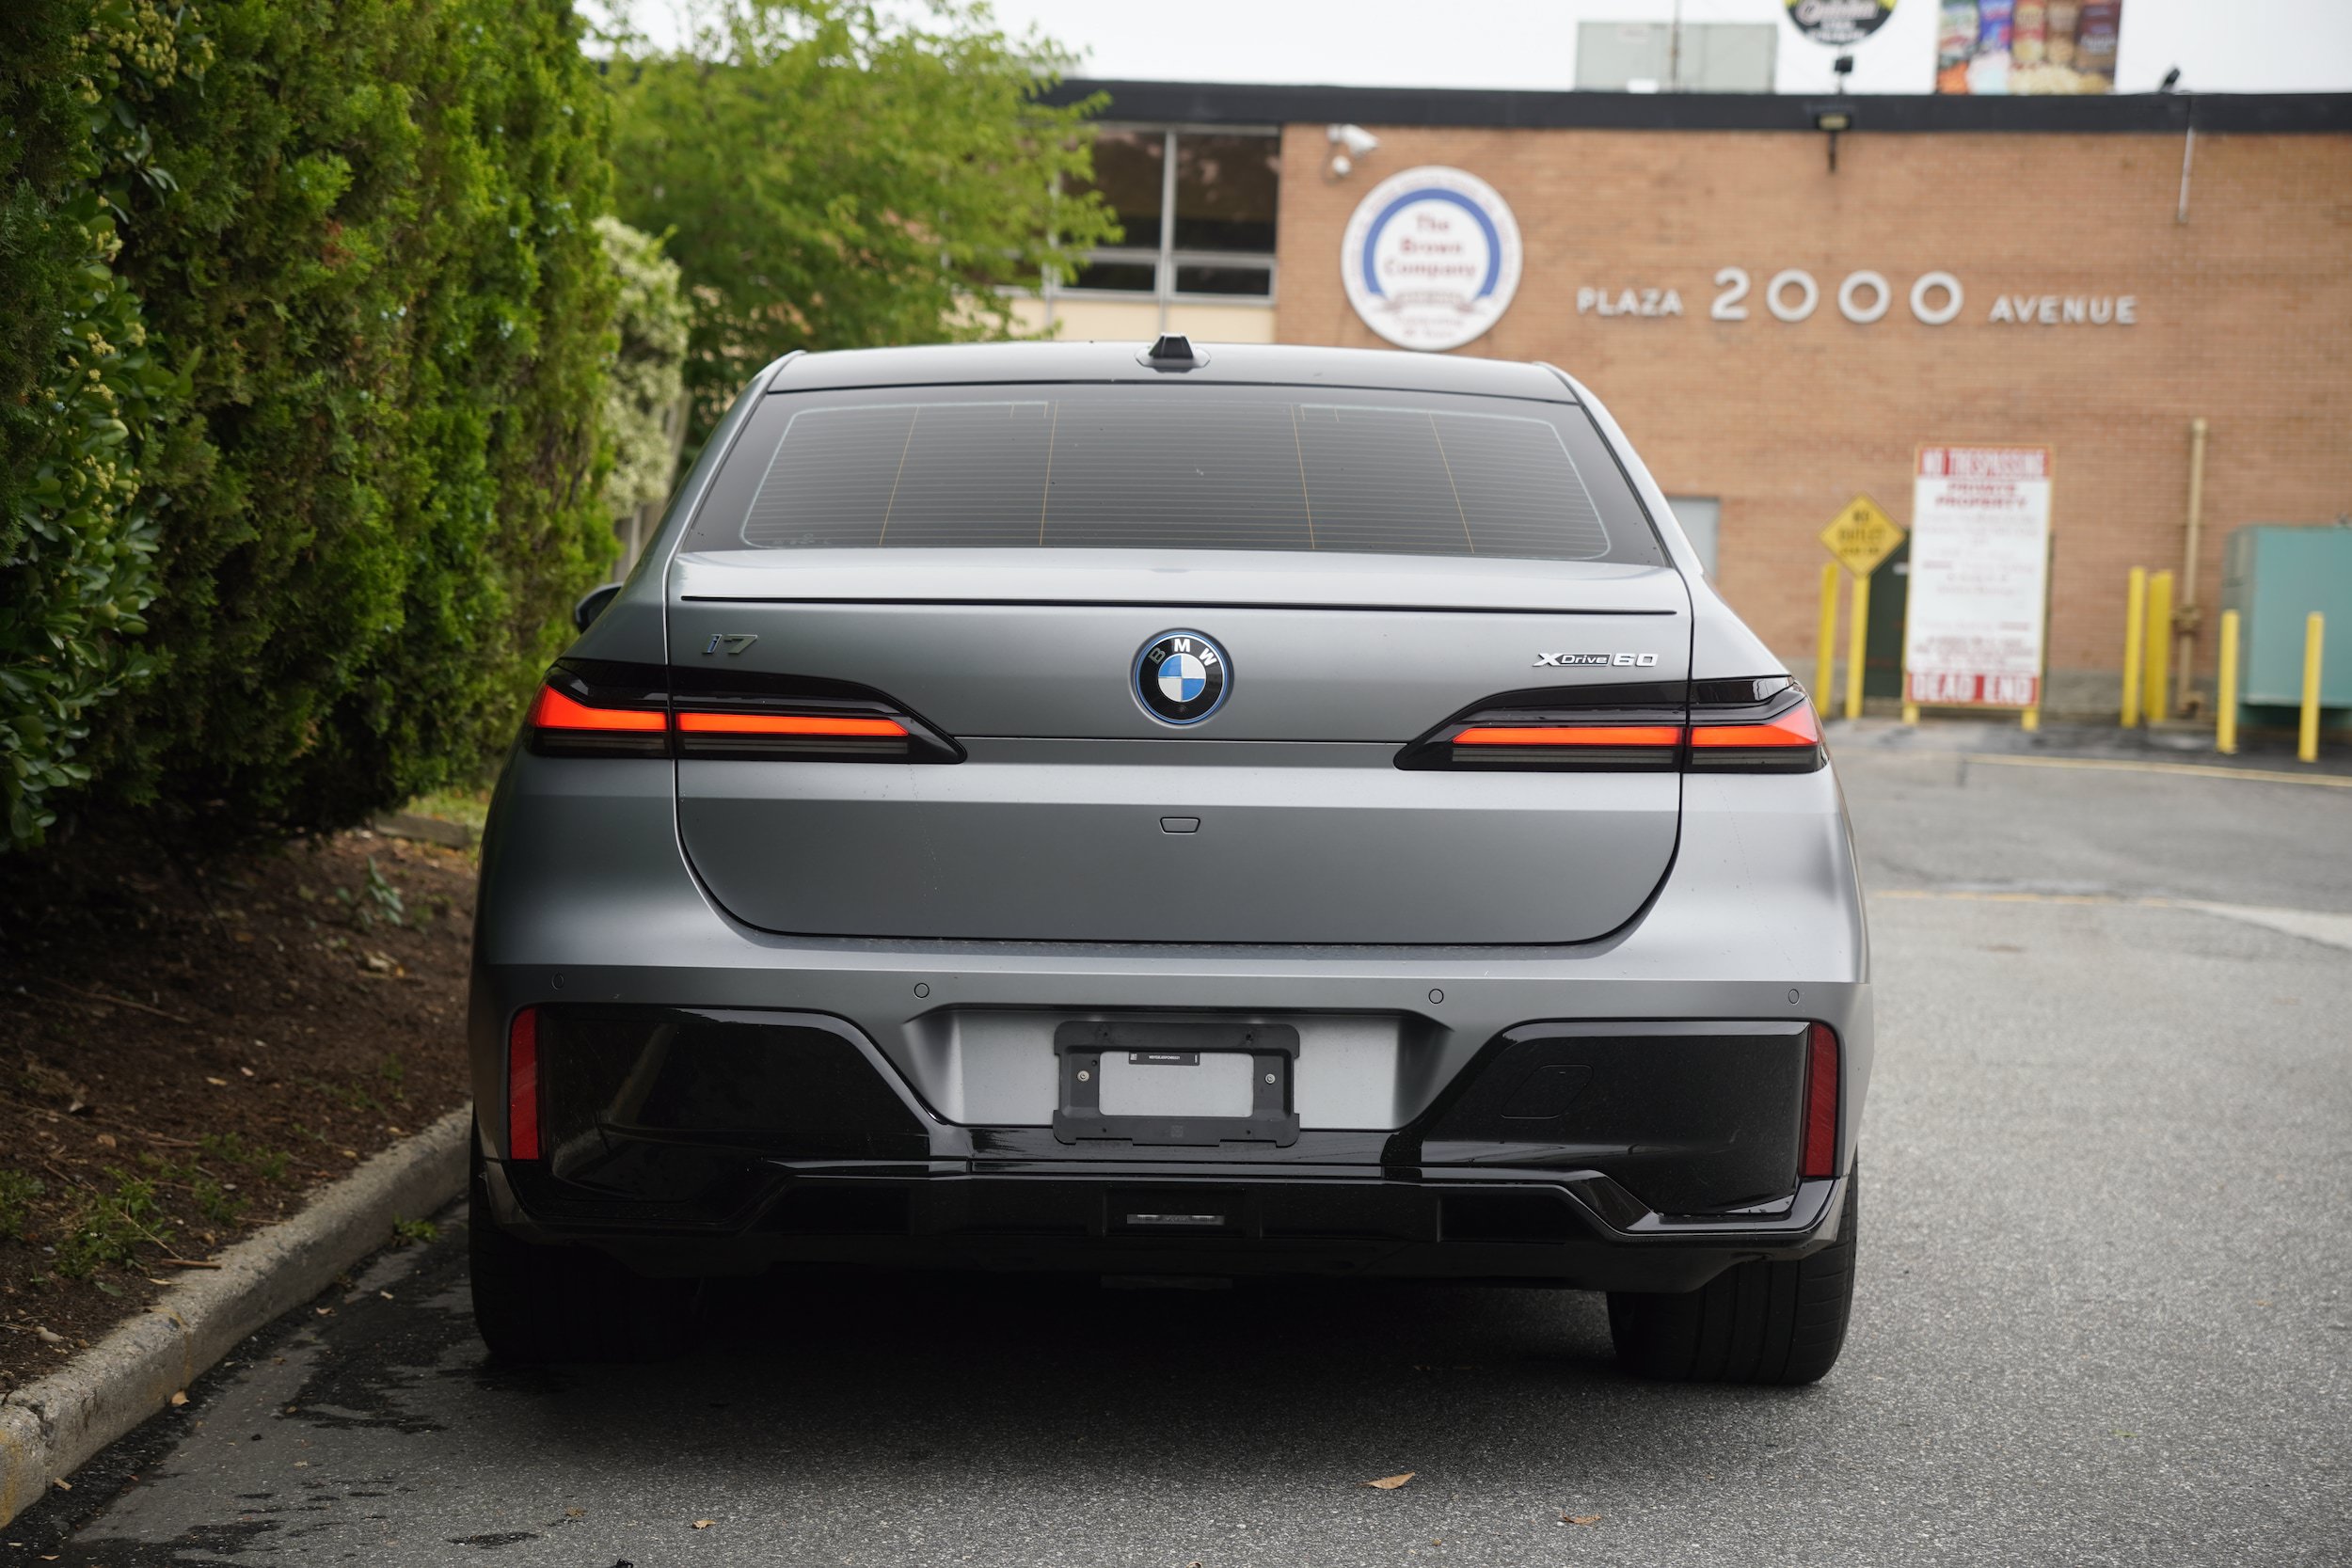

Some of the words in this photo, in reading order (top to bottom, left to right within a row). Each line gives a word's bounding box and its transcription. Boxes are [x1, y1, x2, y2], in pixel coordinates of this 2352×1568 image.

[1384, 260, 1476, 277] Company
[1577, 287, 1683, 317] PLAZA
[1710, 266, 1964, 325] 2000
[1990, 294, 2138, 325] AVENUE
[1935, 497, 2027, 509] PROPERTY
[1148, 638, 1217, 667] BMW
[1911, 673, 1977, 703] DEAD
[1983, 675, 2034, 705] END
